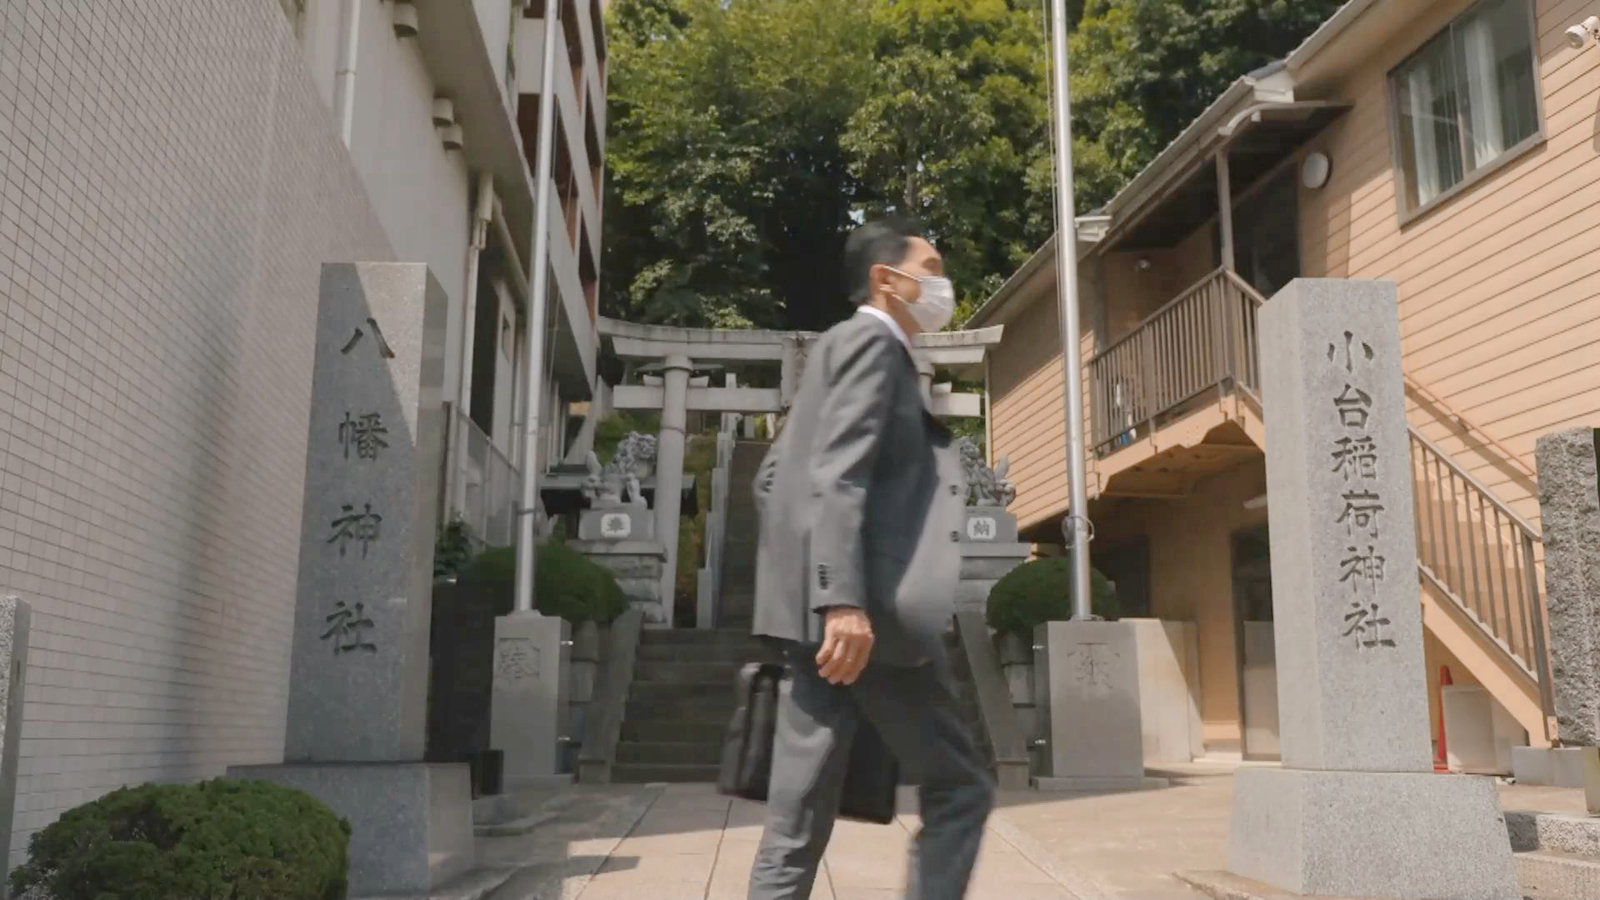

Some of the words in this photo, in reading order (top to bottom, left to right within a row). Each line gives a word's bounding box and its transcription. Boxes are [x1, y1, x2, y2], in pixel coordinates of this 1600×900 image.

[320, 317, 395, 656] 八幡神社
[1326, 330, 1397, 650] 小台稲荷神社
